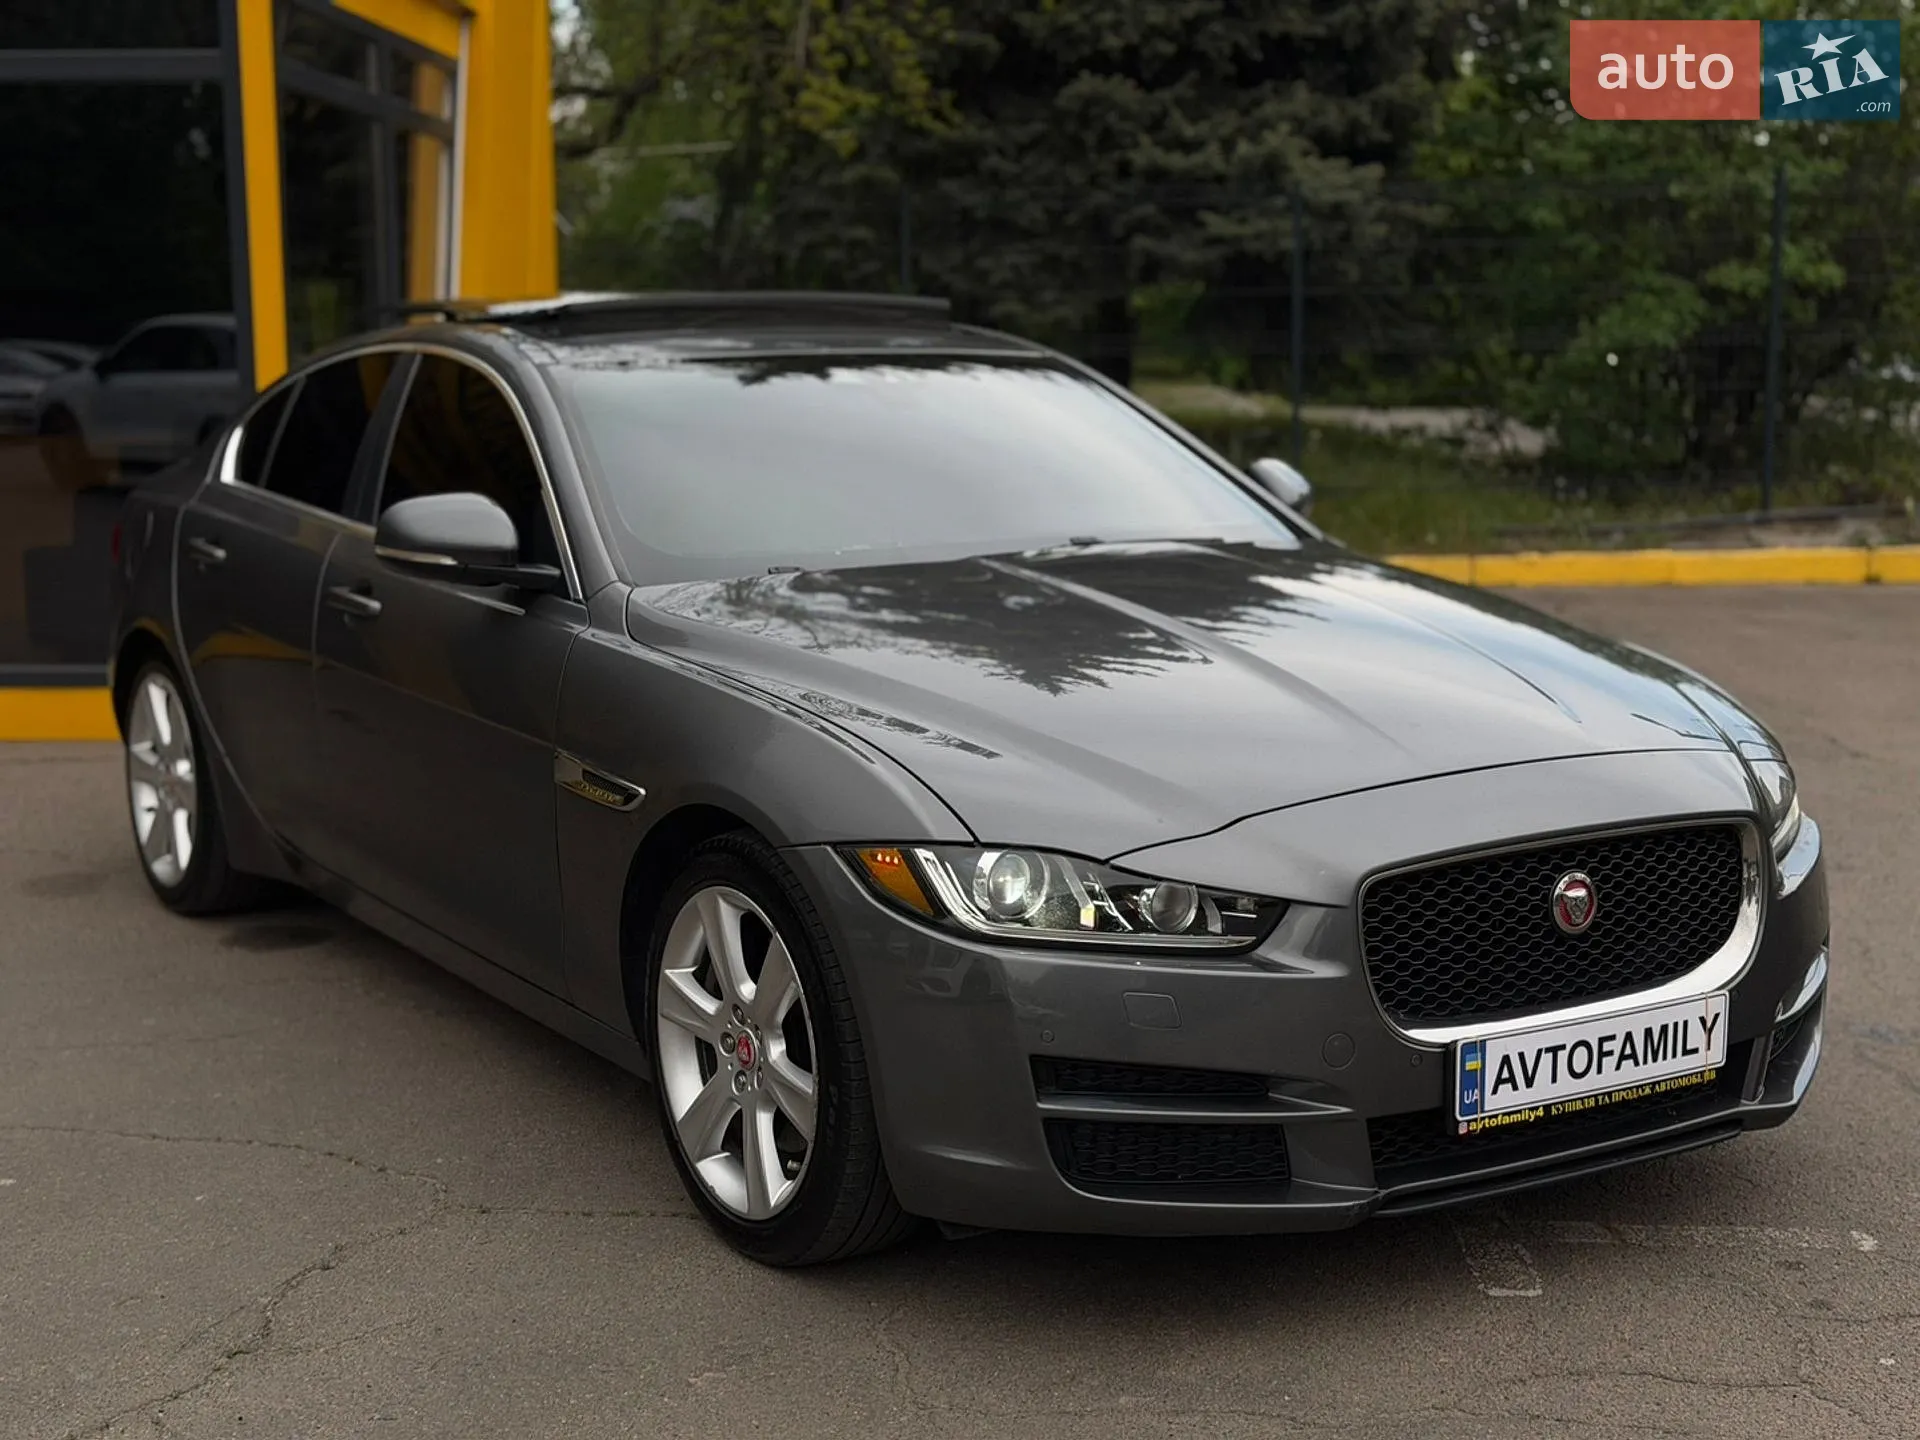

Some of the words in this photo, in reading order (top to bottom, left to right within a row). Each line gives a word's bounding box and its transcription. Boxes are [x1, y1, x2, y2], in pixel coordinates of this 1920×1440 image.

[1491, 1012, 1720, 1096] AVTOFAMILY
[1464, 1088, 1480, 1104] UA
[1597, 1094, 1610, 1105] ТА
[1611, 1085, 1652, 1102] ПРОДАЖ
[1469, 1106, 1544, 1131] avtofamily4
